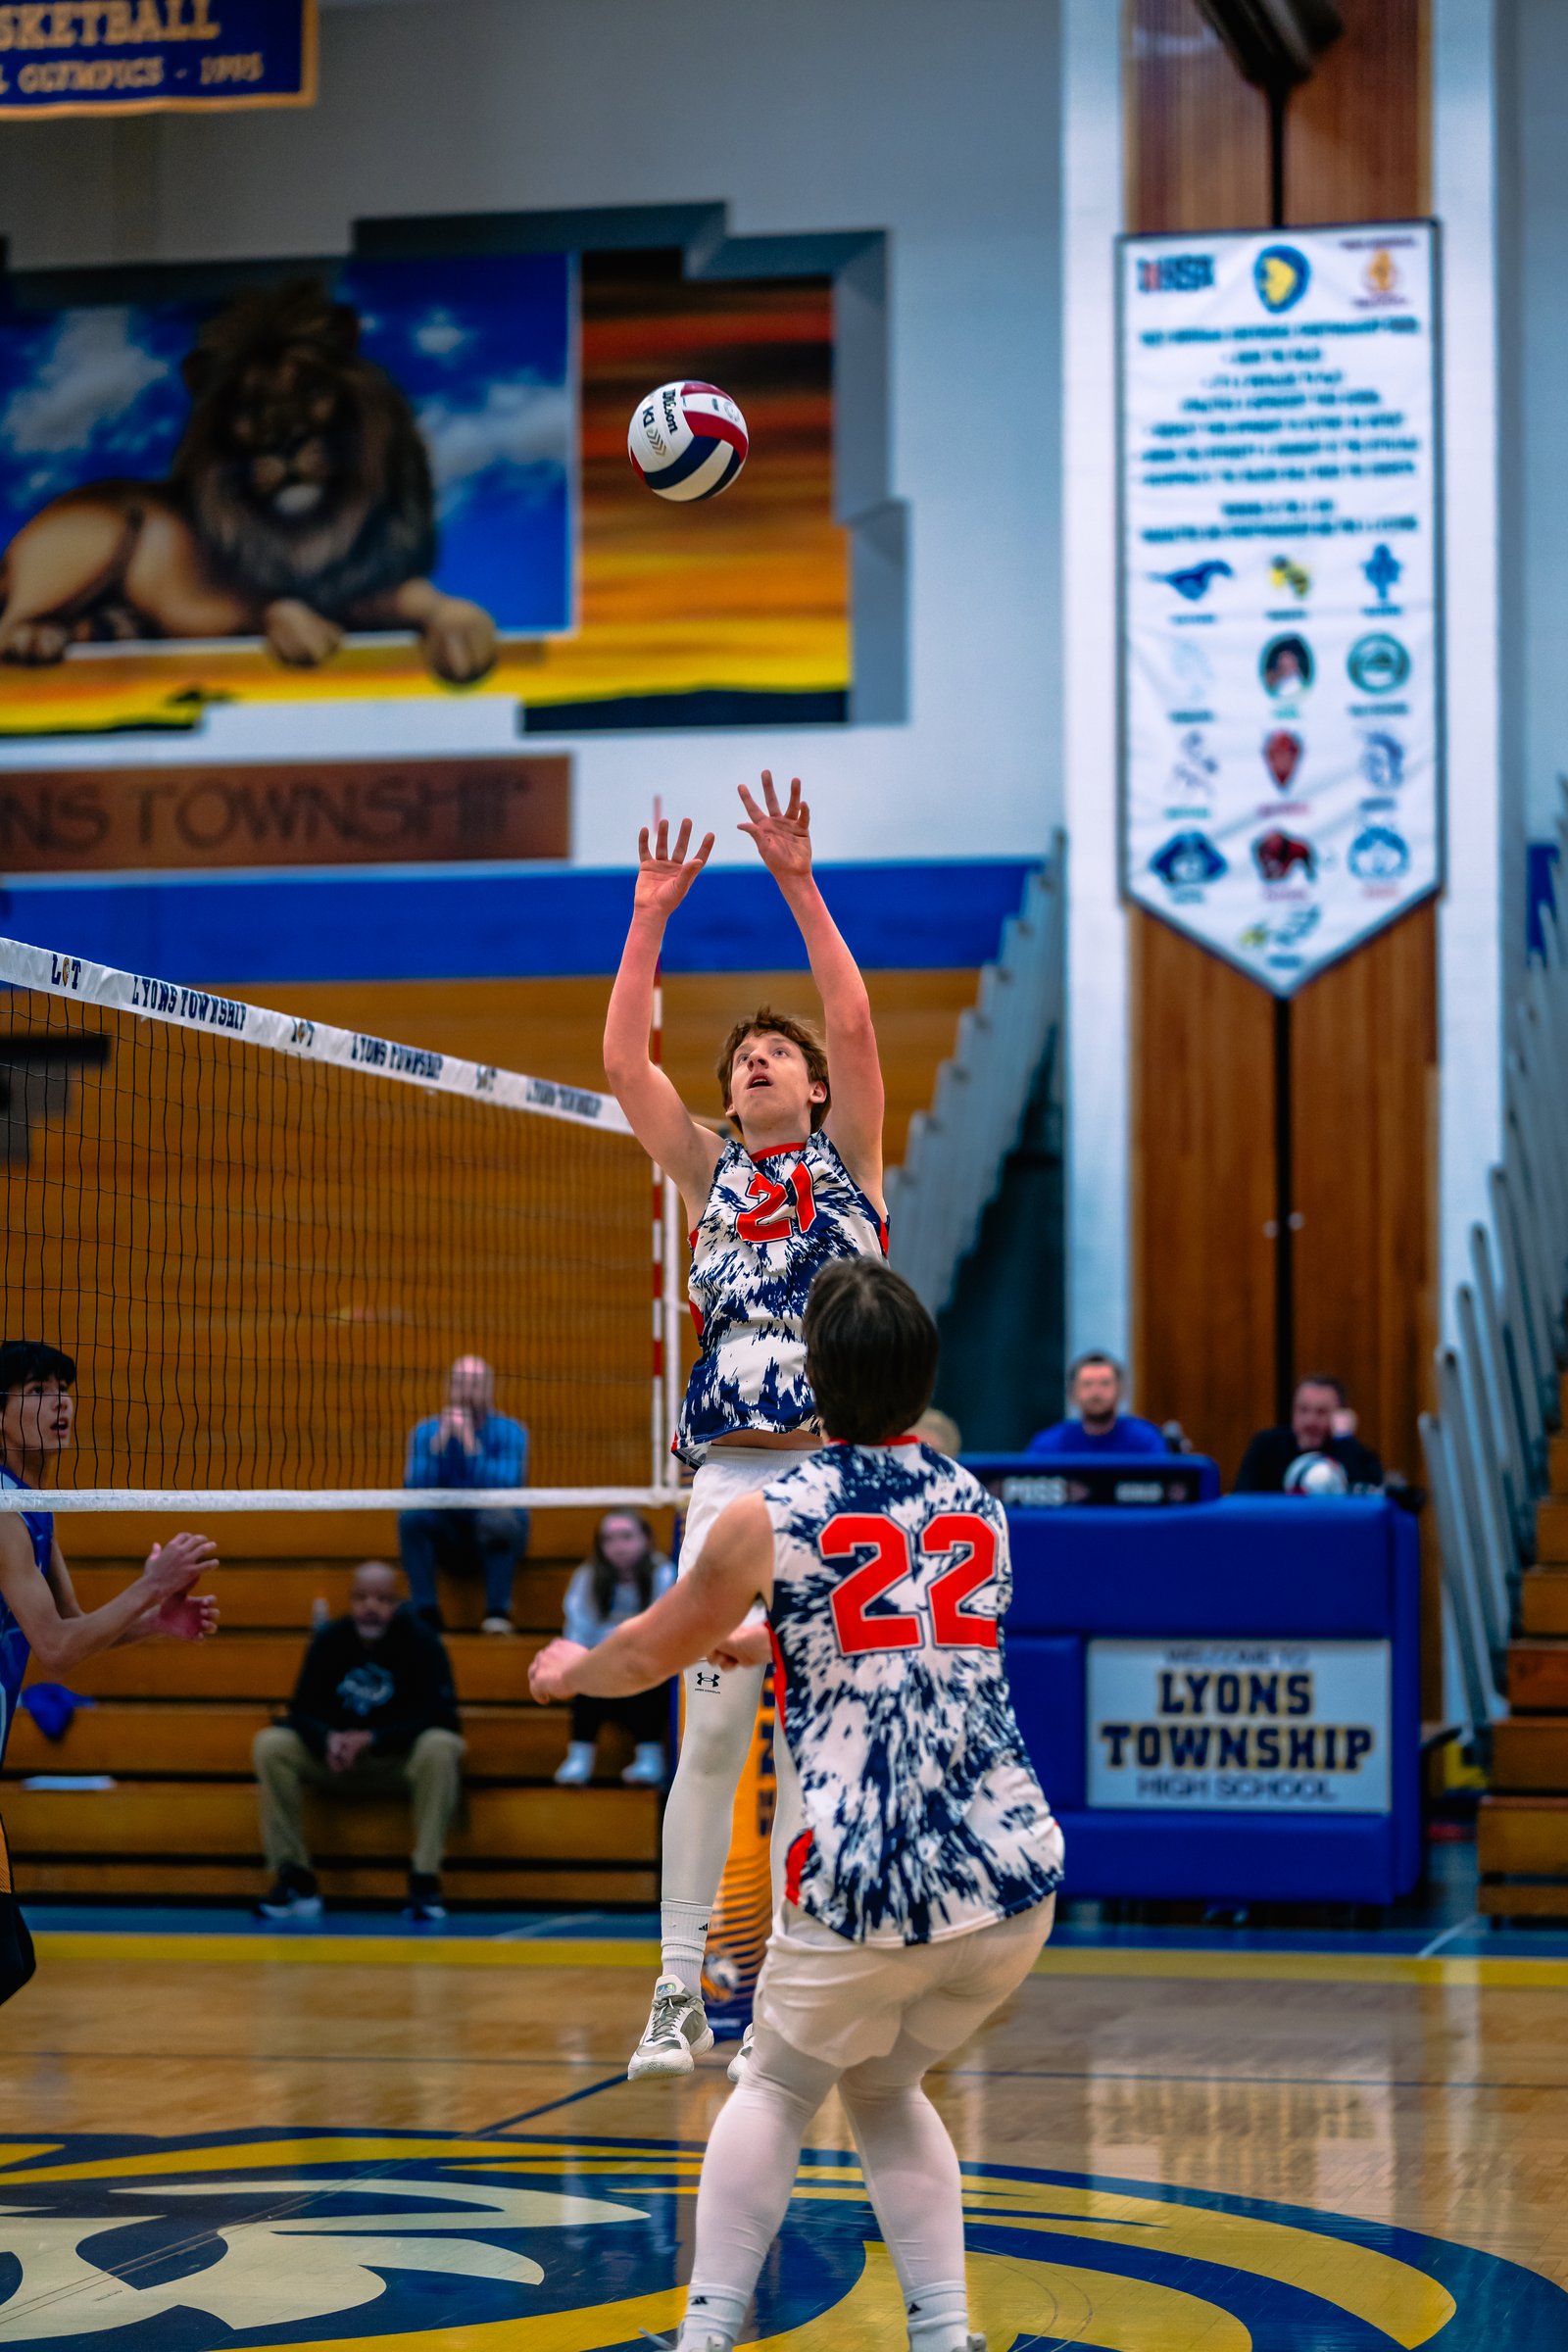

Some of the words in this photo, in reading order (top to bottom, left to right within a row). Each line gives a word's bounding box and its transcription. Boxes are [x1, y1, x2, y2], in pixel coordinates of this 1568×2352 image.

[131, 975, 177, 1013] LYONS
[179, 988, 247, 1031] TOWNSHIP
[735, 1160, 817, 1244] 21
[818, 1512, 1000, 1657] 22
[1158, 1672, 1312, 1715] LYONS
[1100, 1723, 1374, 1771] TOWNSHIP
[1137, 1776, 1209, 1798] HIGH
[1216, 1776, 1337, 1802] SCHOOL
